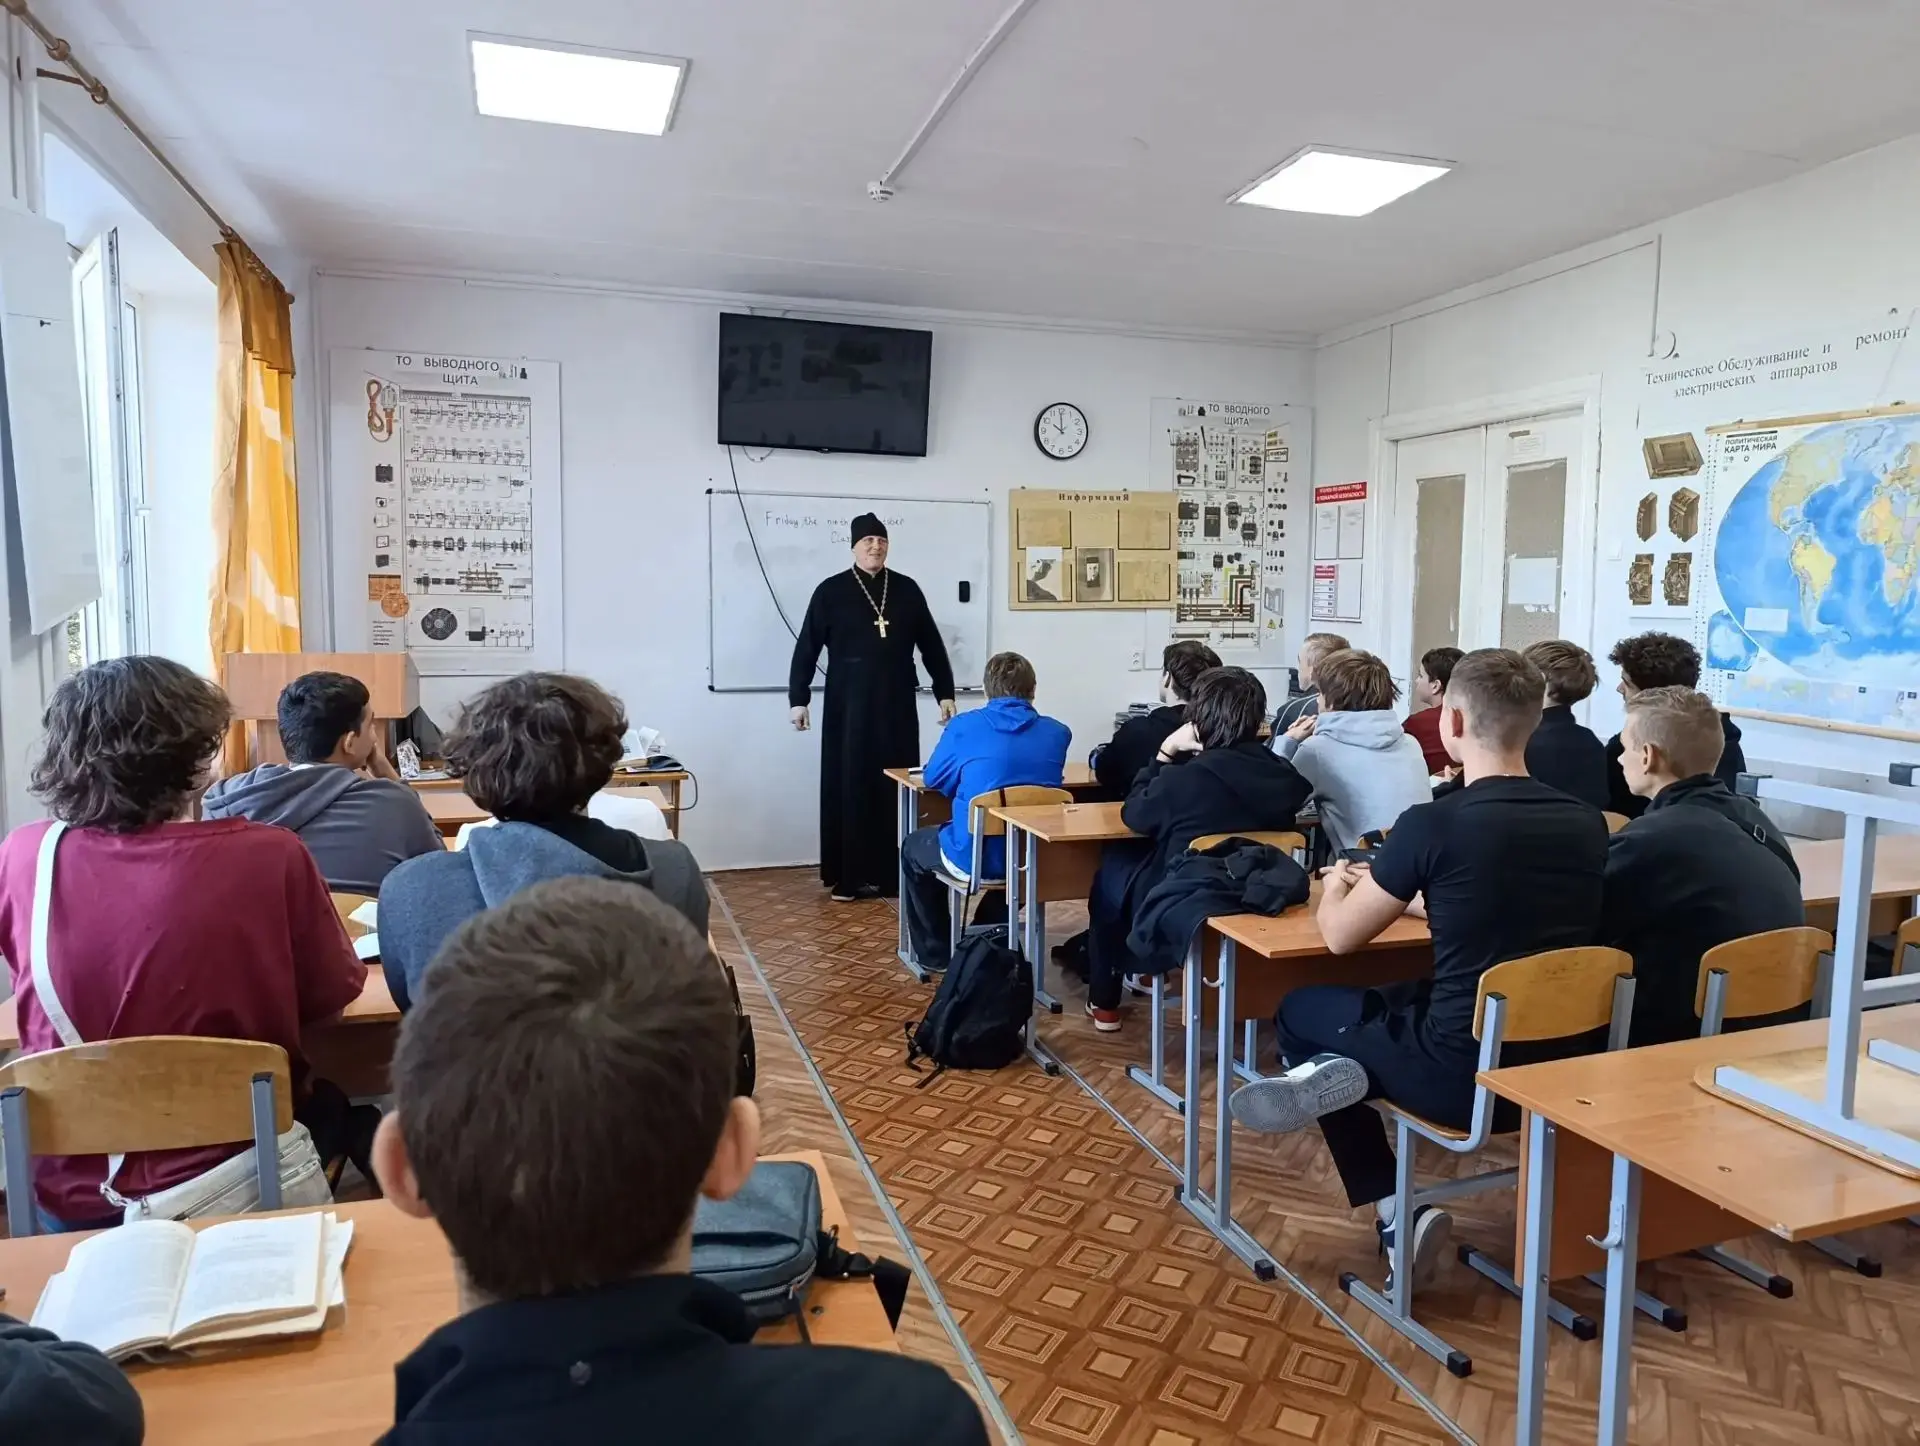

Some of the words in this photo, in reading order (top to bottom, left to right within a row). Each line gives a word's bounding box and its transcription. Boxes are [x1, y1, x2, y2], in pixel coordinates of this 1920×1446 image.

[1645, 364, 1714, 385] Техническое
[1717, 347, 1810, 372] Обслуживание
[1822, 343, 1831, 354] и
[1855, 326, 1910, 350] ремонт
[396, 355, 412, 366] ТО
[424, 357, 499, 372] ВЫВОДНОГО
[442, 373, 478, 386] ЩИТА
[1675, 374, 1756, 398] электрических
[1770, 360, 1838, 380] аппаратов
[1208, 403, 1220, 413] ТО
[1224, 404, 1270, 415] ВВОДНОГО
[1224, 416, 1250, 426] ЩИТА
[1725, 434, 1778, 445] ПОЛИТИЧЕСКАЯ
[1724, 444, 1750, 454] КАРТА
[1752, 442, 1777, 451] МИРА
[765, 511, 799, 528] Friday
[804, 516, 817, 526] the
